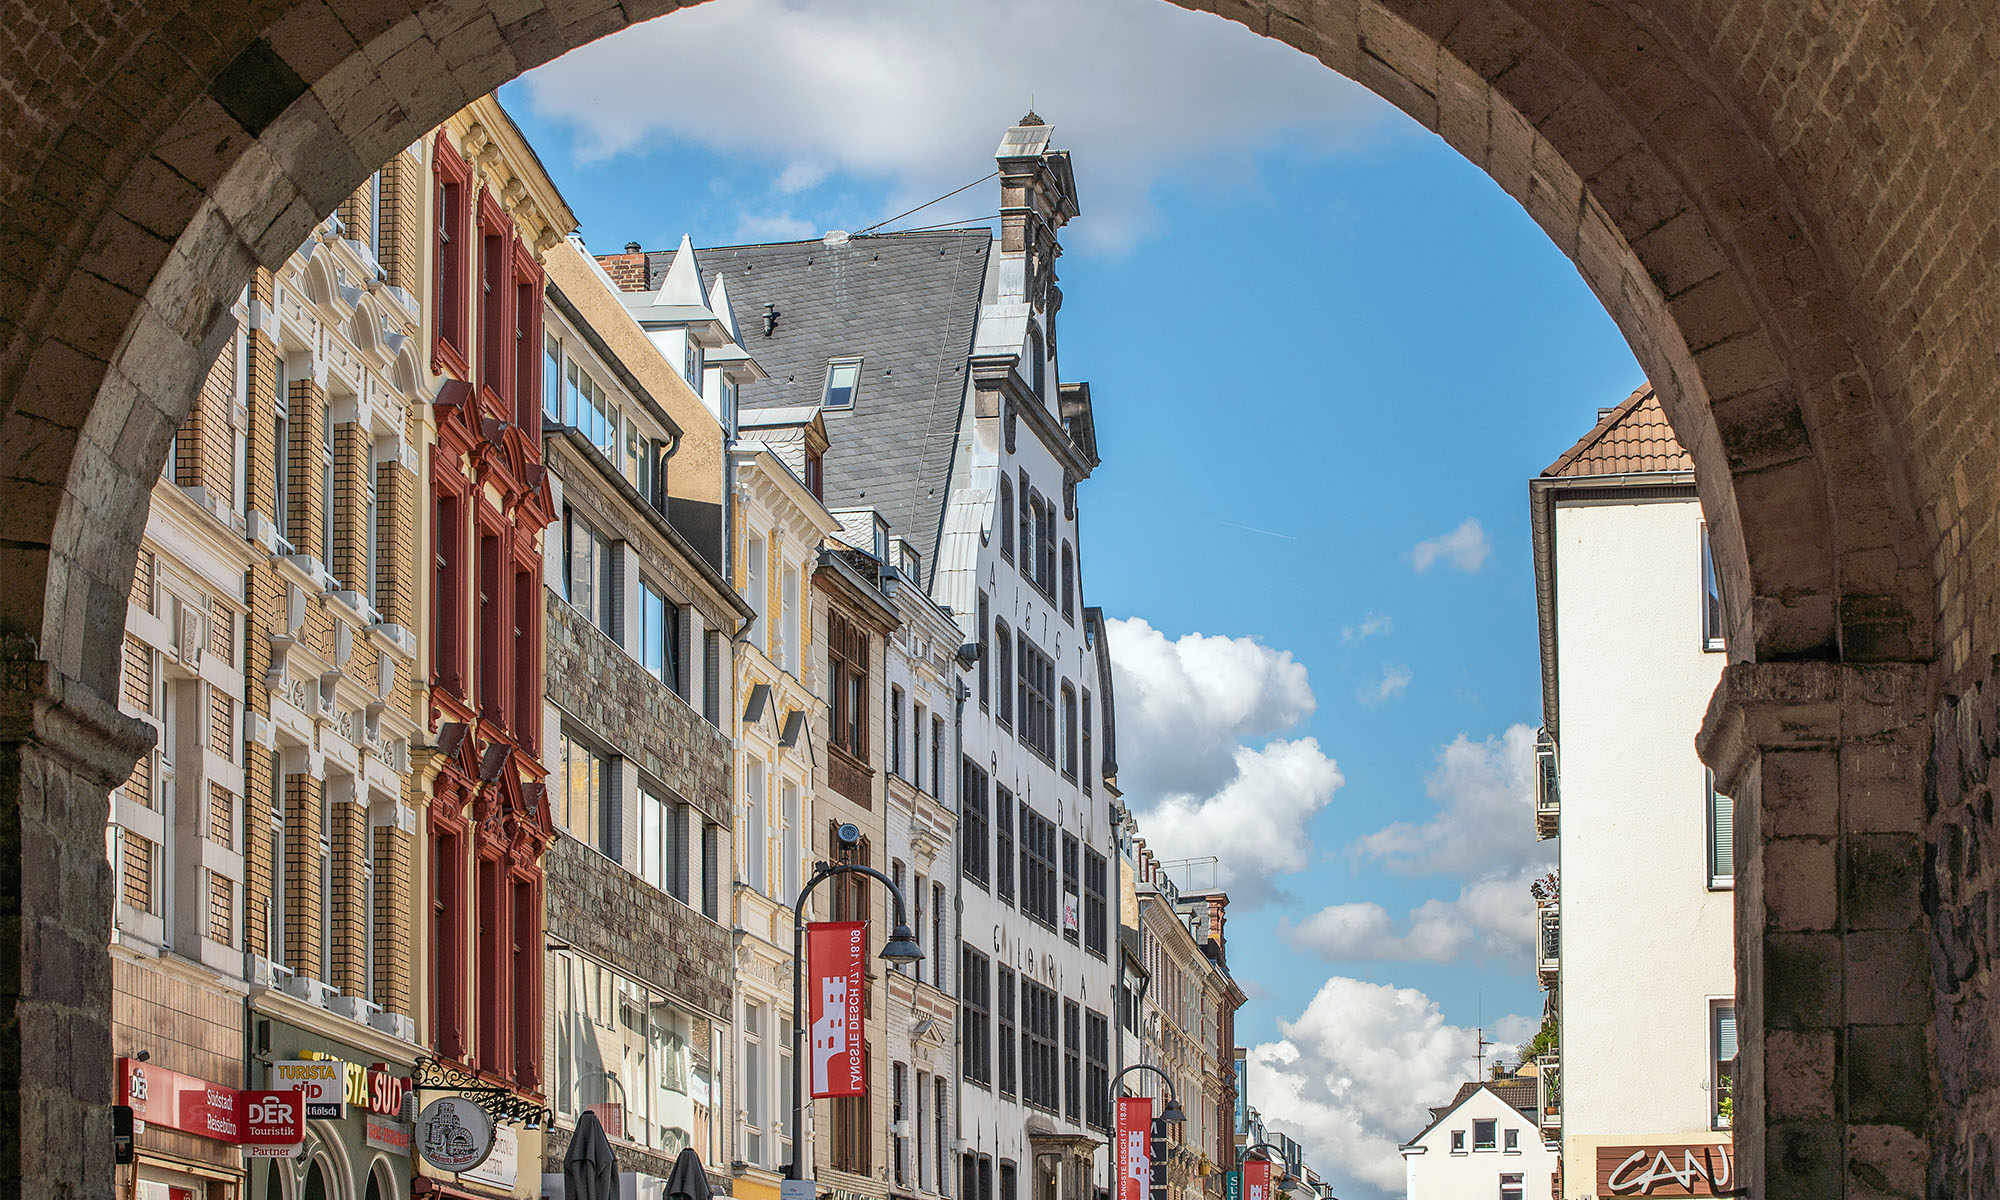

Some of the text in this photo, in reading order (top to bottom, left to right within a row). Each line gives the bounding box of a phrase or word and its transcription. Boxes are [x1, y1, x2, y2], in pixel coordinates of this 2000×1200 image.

[278, 1065, 337, 1079] TURISTA
[373, 1062, 402, 1116] SÜD
[206, 1089, 233, 1111] Südstadt
[249, 1104, 294, 1124] DER
[207, 1113, 237, 1136] Reisebüro
[250, 1127, 295, 1136] Touristik
[252, 1147, 290, 1156] Partner
